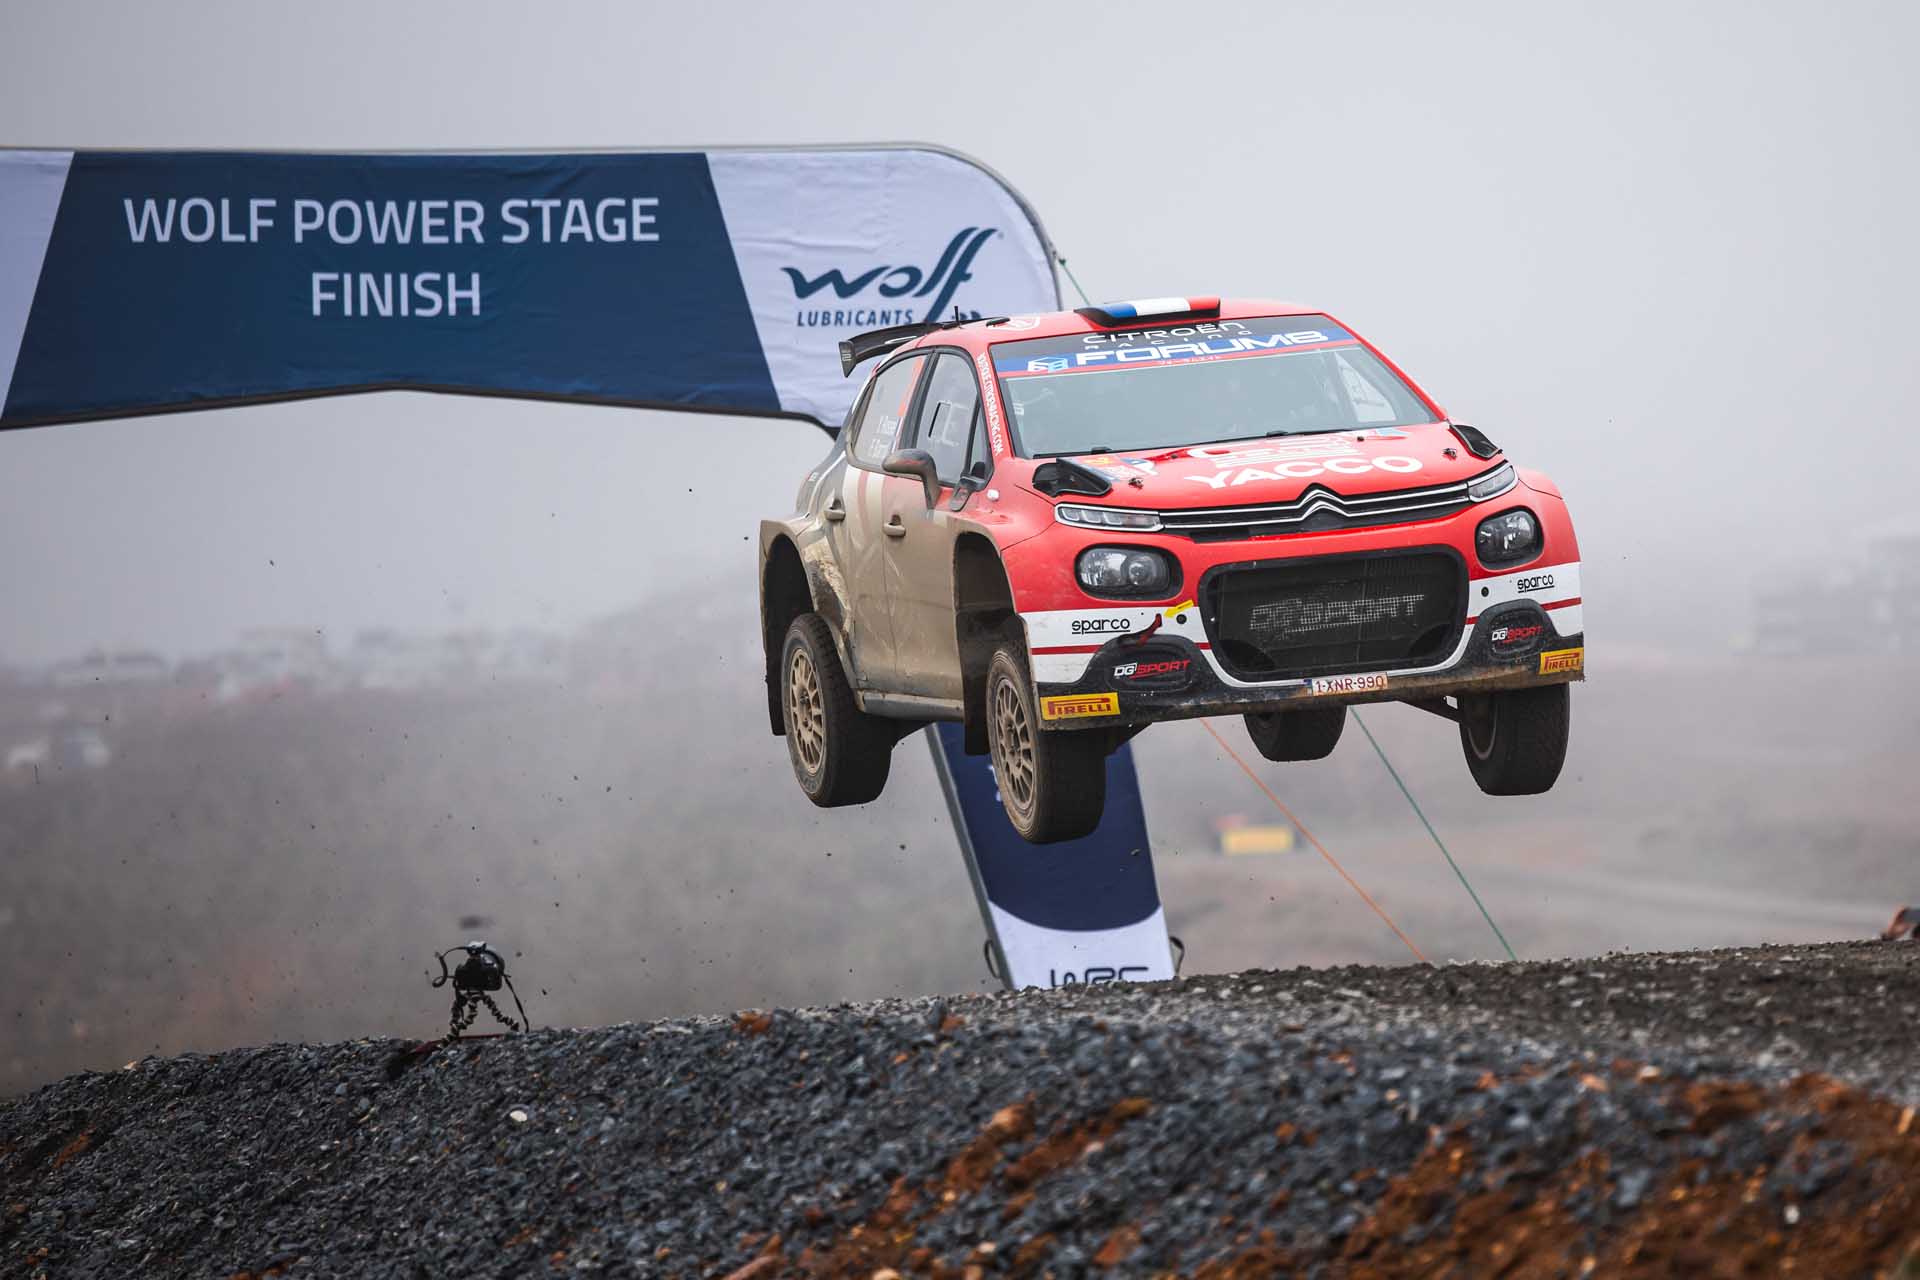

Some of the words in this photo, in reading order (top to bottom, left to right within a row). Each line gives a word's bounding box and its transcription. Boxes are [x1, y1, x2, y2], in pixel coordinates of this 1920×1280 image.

[124, 198, 276, 243] WOLF
[294, 200, 485, 244] POWER
[501, 197, 660, 242] STAGE
[312, 272, 481, 316] FINISH
[797, 309, 913, 327] LUBRICANTS
[1184, 456, 1423, 489] YACCO
[1517, 574, 1555, 593] sparco
[1071, 617, 1130, 635] sparco
[1543, 652, 1580, 672] PIRELLI
[1315, 675, 1384, 693] 1-XNR-990
[1047, 697, 1112, 716] PIRELLI
